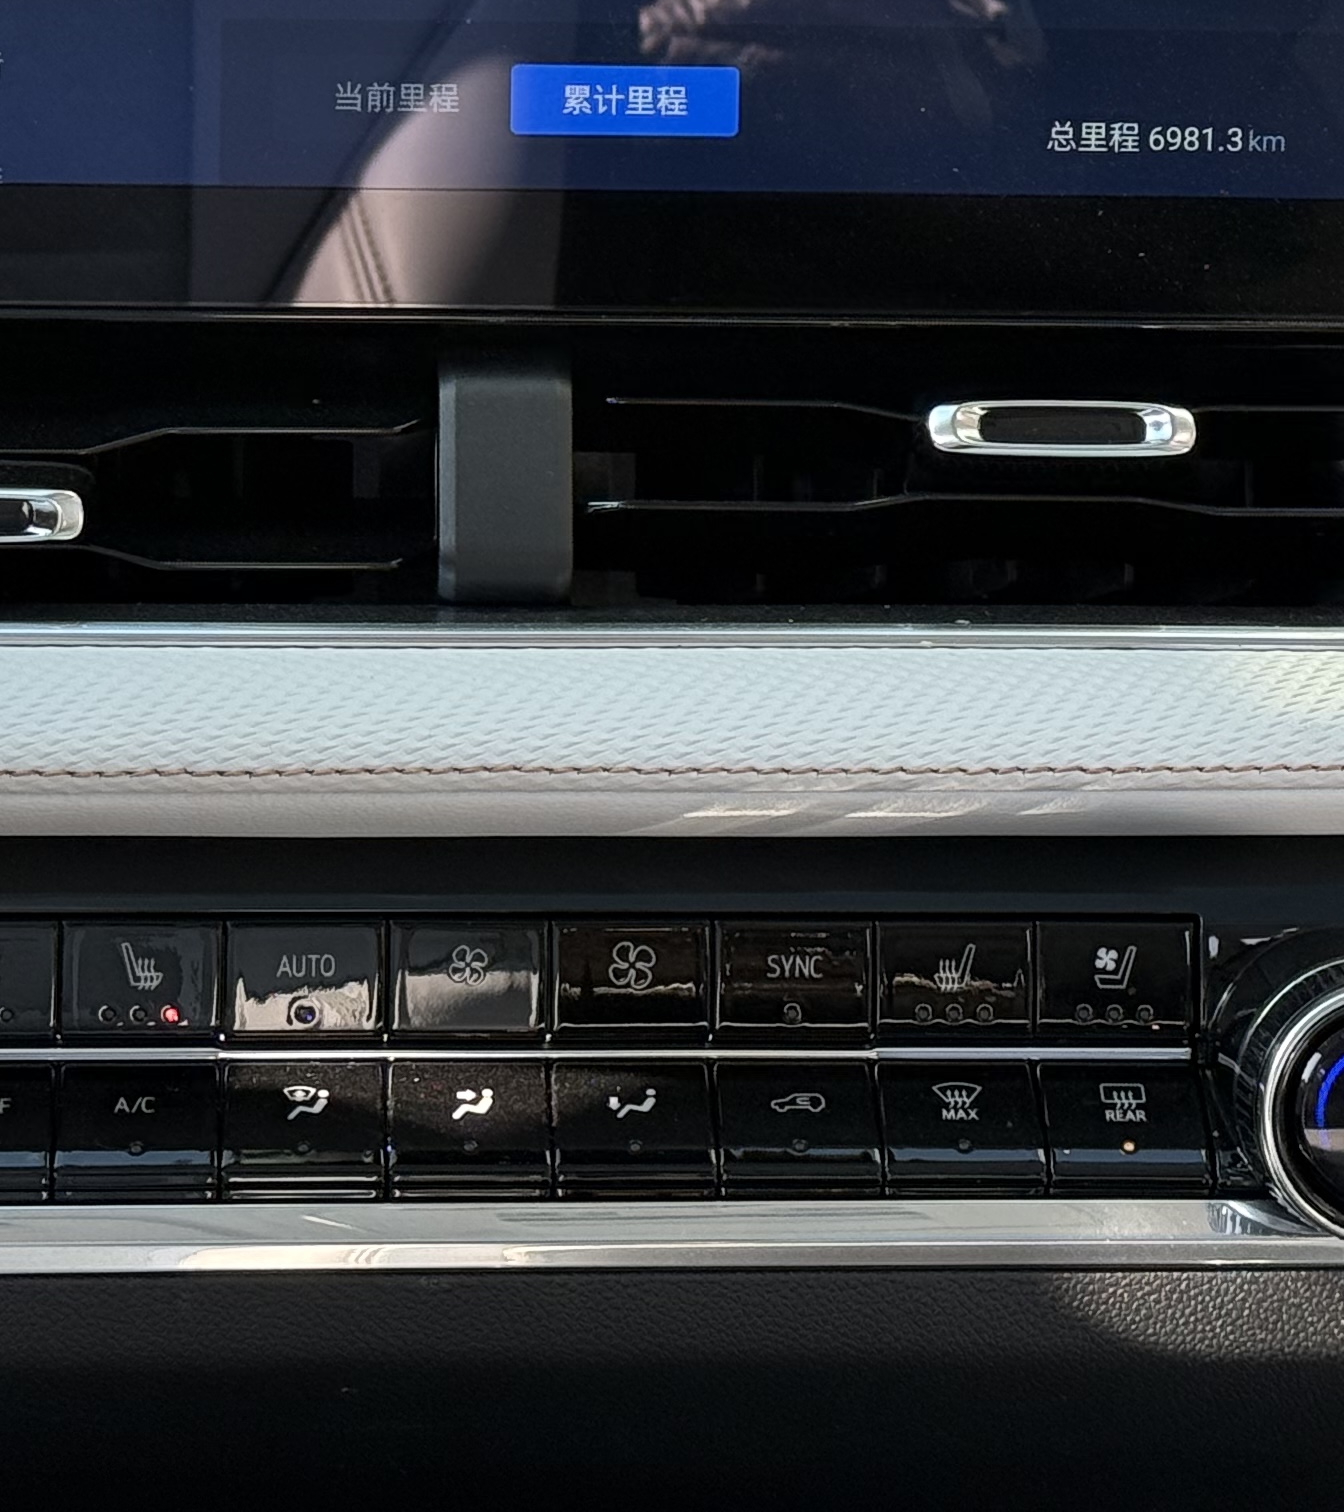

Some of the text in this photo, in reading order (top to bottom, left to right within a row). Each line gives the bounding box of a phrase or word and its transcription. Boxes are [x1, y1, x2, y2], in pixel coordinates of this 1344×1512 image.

[335, 82, 460, 114] 当前里程
[562, 84, 690, 117] 累计里程
[1046, 120, 1287, 153] 总里程 6981.3 km
[276, 953, 337, 979] AUTO
[766, 954, 824, 979] SYNC
[113, 1096, 156, 1115] A/C
[941, 1107, 980, 1122] MAX
[1104, 1109, 1148, 1123] REAR
